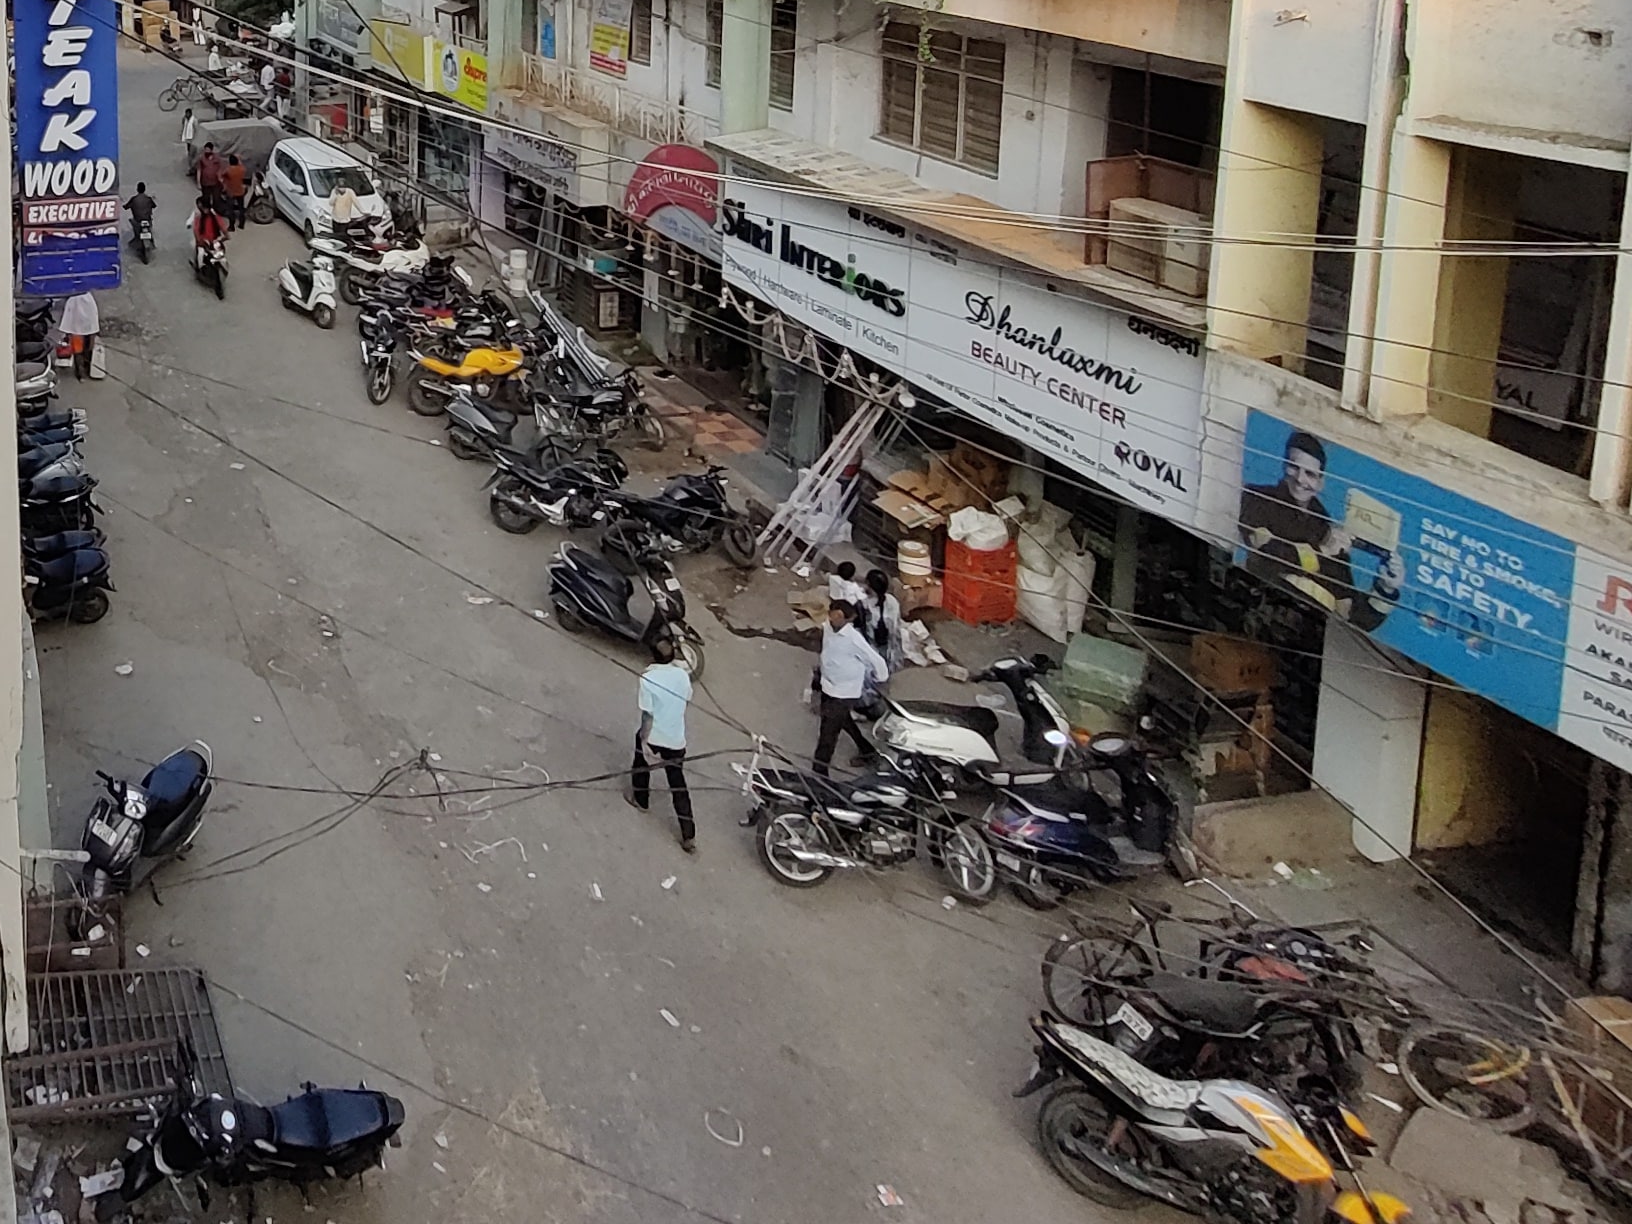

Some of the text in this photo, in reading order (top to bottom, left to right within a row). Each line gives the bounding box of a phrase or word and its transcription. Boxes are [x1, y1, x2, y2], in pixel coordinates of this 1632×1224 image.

[24, 158, 117, 198] WOOD
[28, 200, 117, 224] EXECUTIVE
[722, 198, 773, 255] Shri
[861, 324, 899, 356] Kitchen
[965, 290, 1143, 396] Dhanlaxmi
[971, 340, 1127, 430] BEAUTY CENTER
[1113, 440, 1187, 493] ROYAL
[1419, 532, 1462, 562] FIRE
[1421, 517, 1525, 572] SAY NO TO
[1419, 549, 1486, 589] YES TO
